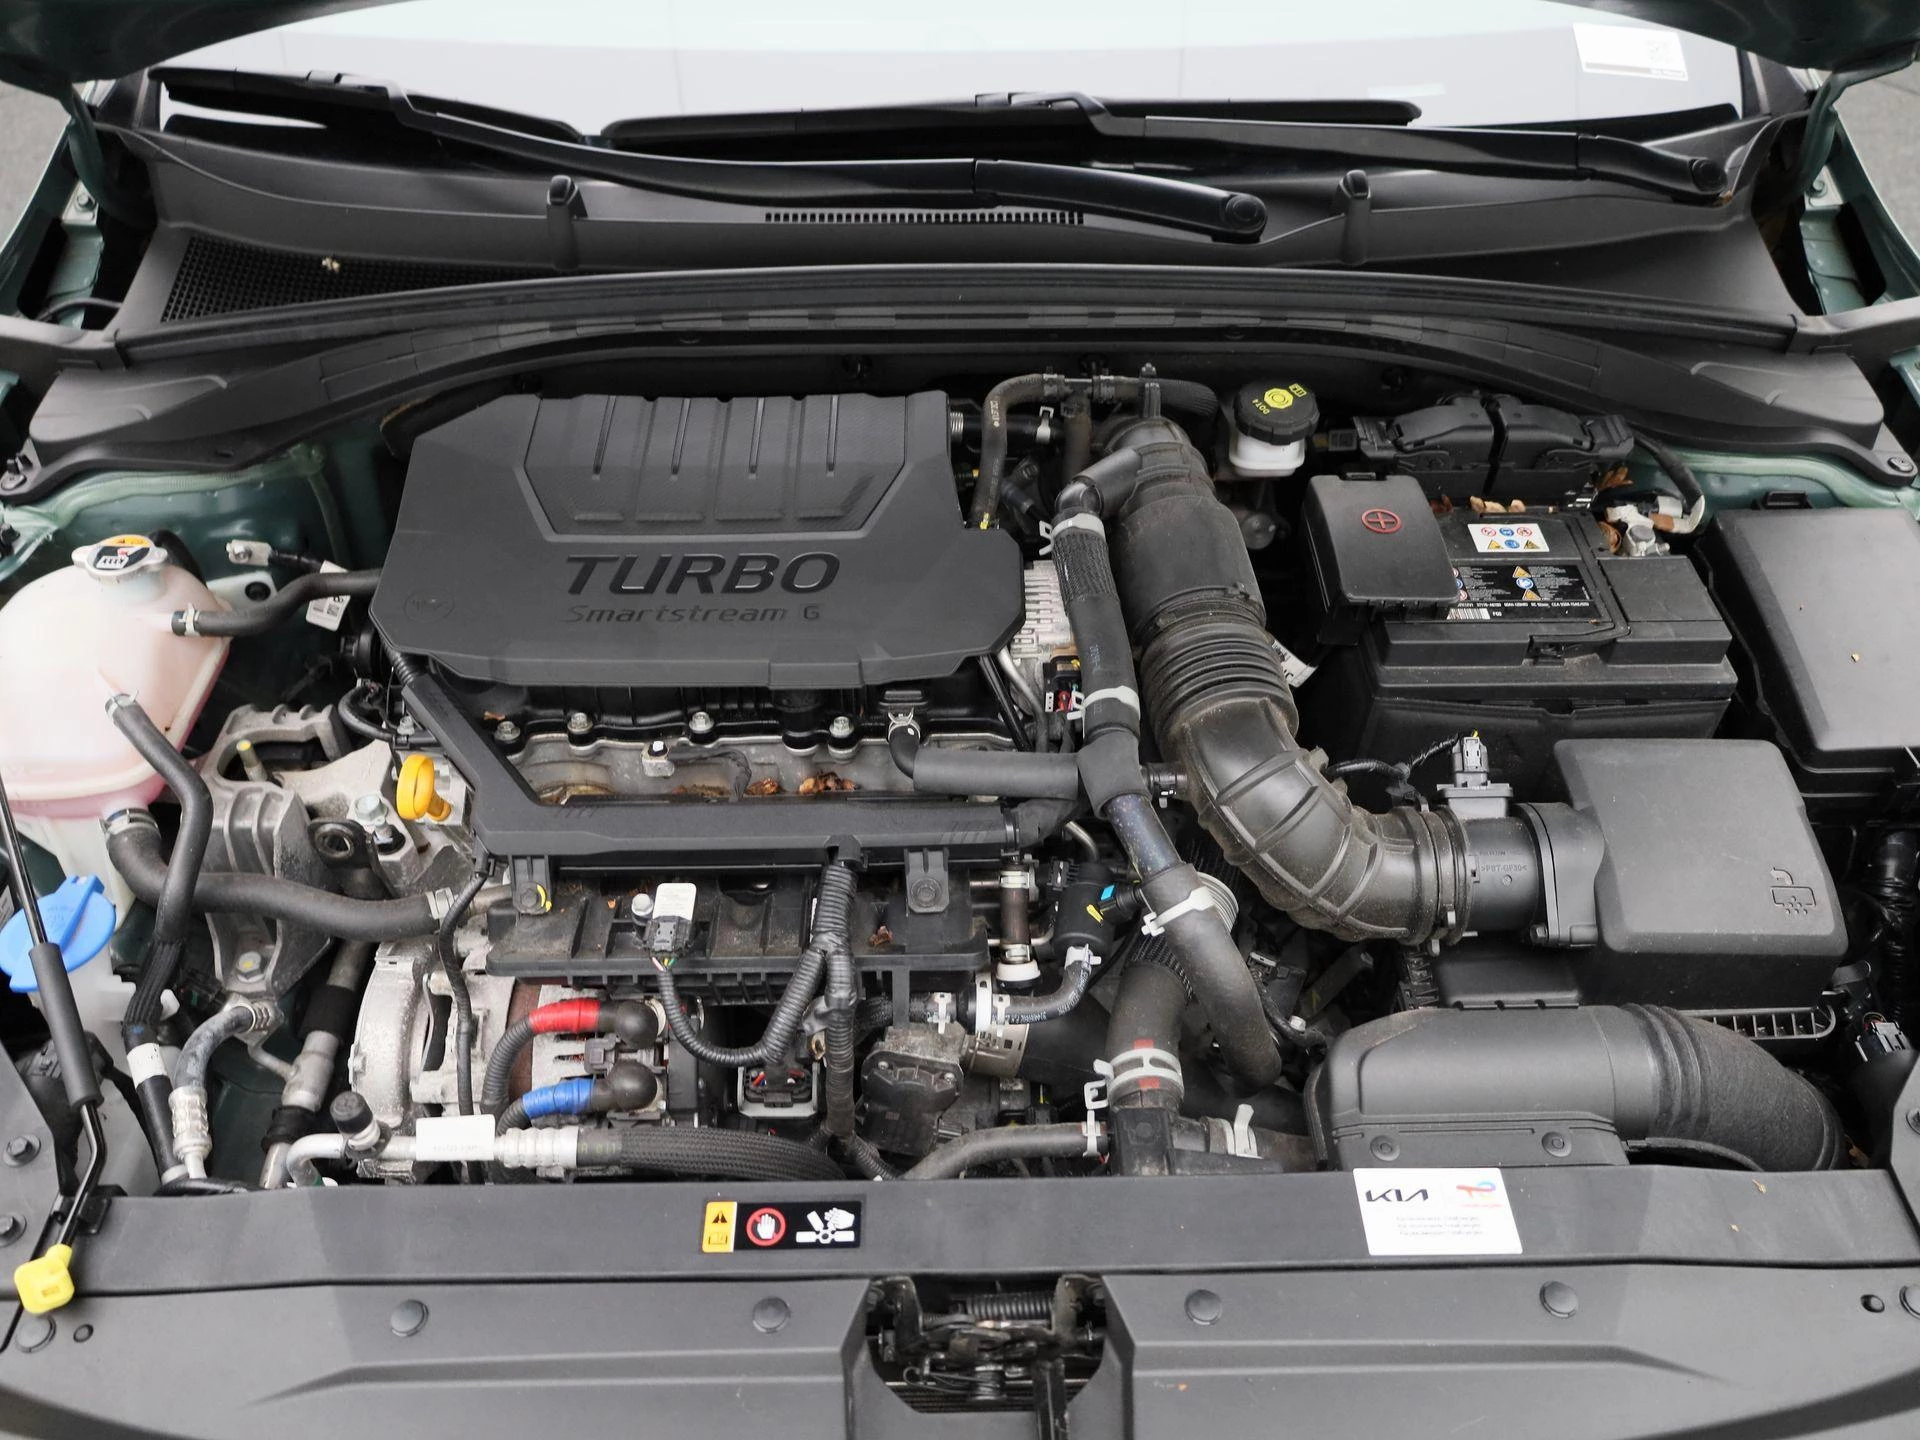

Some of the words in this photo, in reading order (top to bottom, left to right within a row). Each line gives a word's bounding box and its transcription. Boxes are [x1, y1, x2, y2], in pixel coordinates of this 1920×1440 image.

[566, 552, 841, 595] TURBO
[566, 604, 787, 623] Smartstream
[803, 603, 821, 621] G
[1365, 1188, 1429, 1203] KIA
